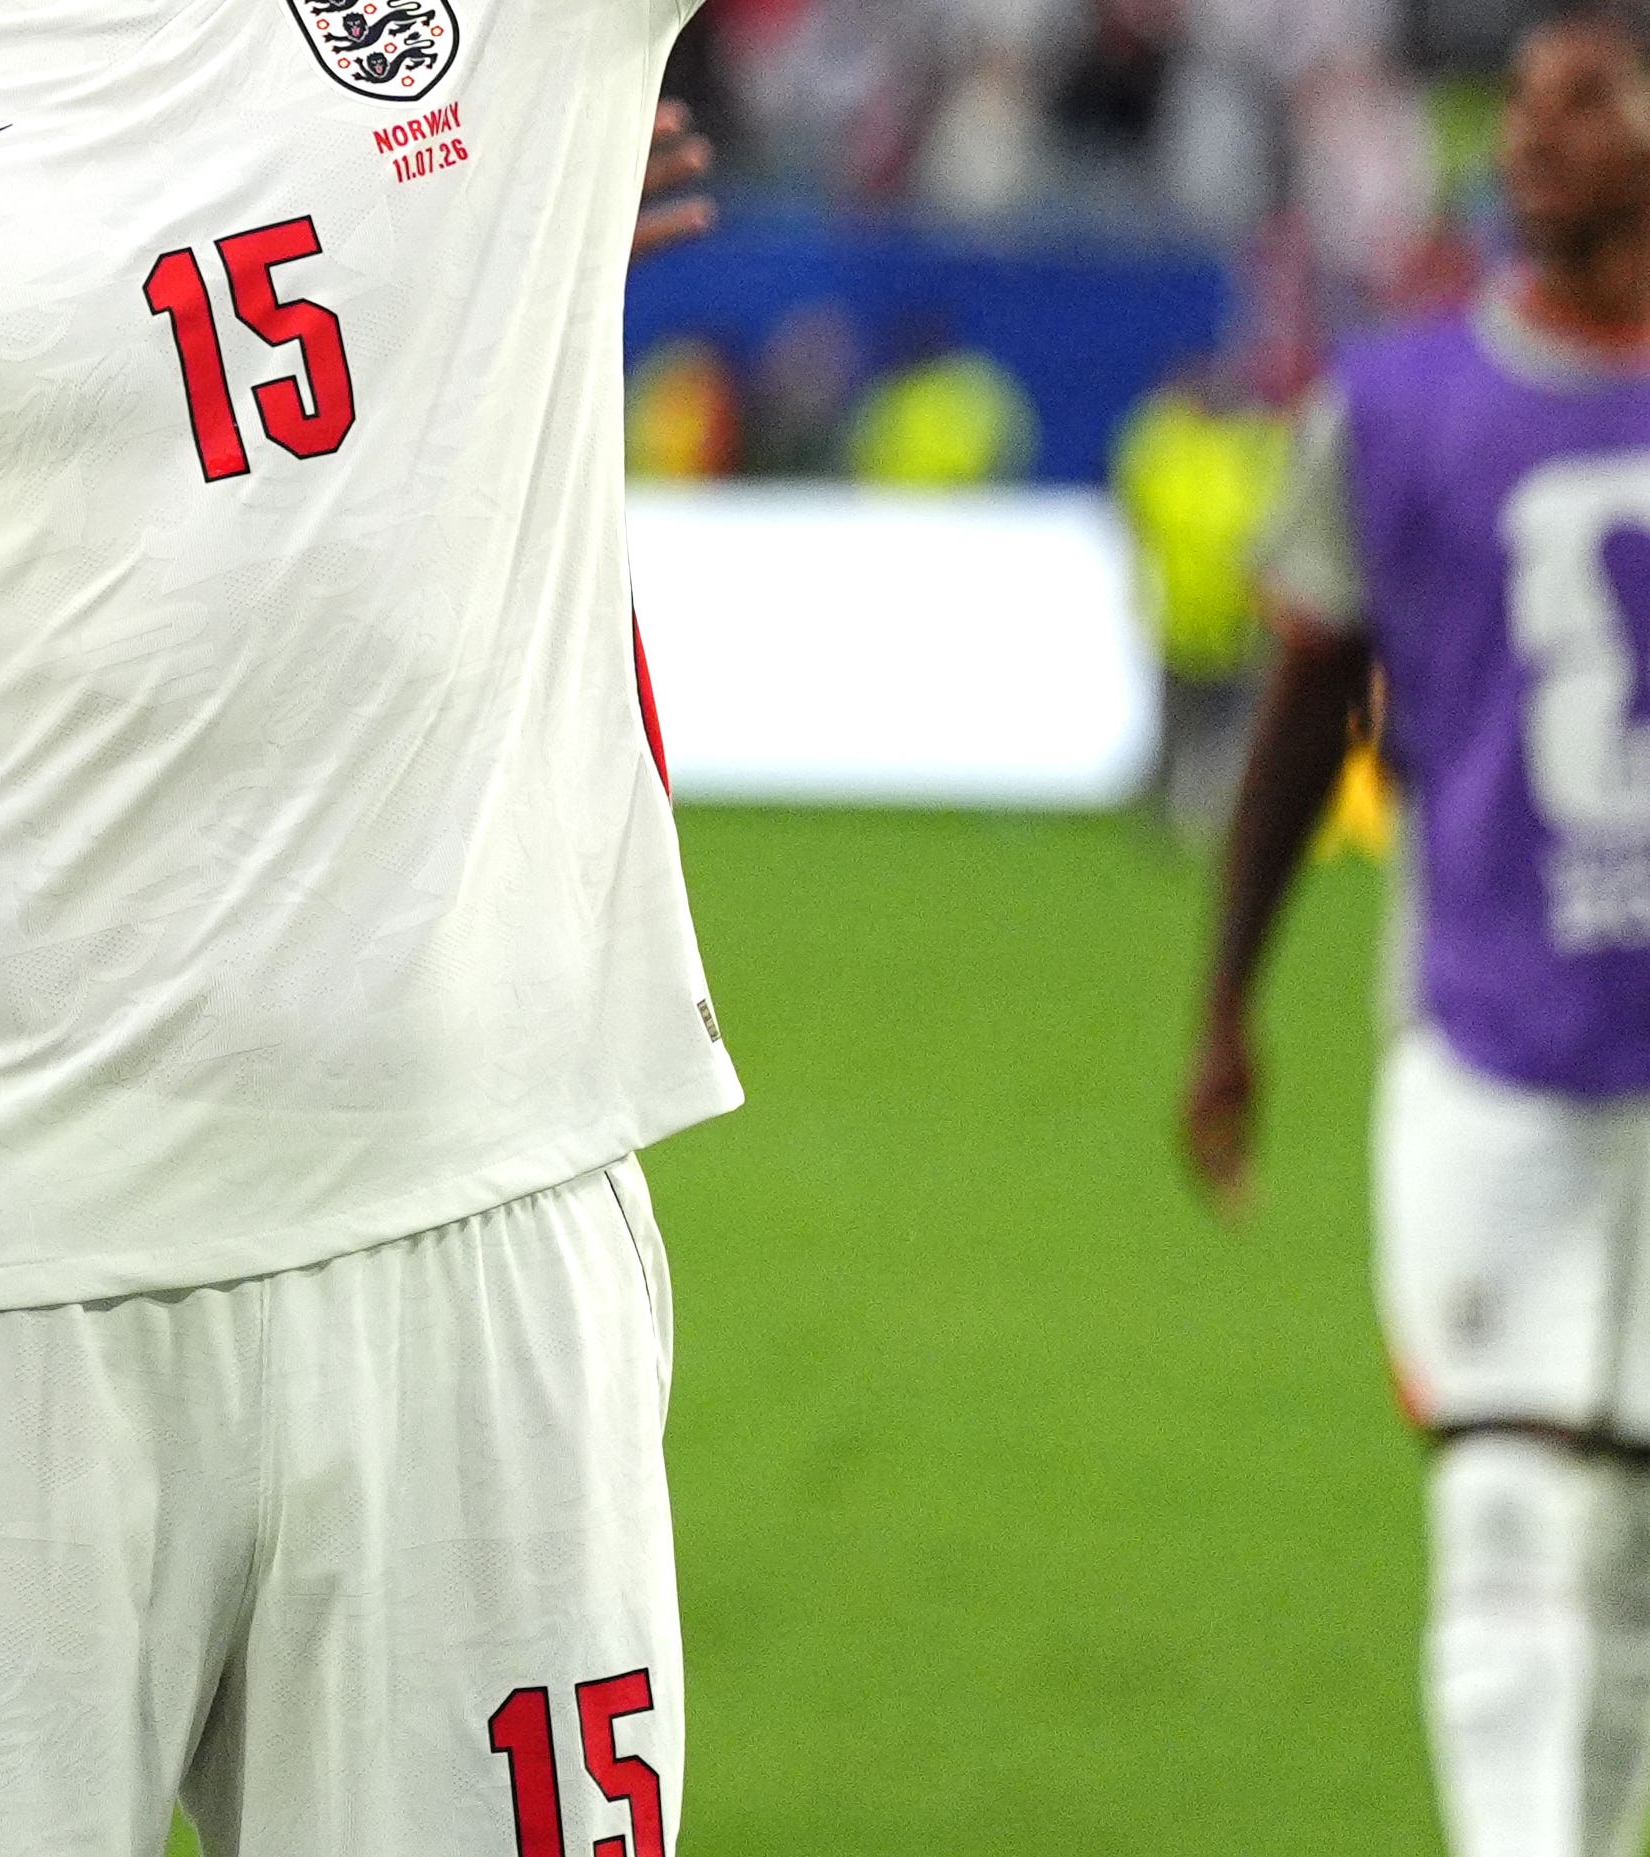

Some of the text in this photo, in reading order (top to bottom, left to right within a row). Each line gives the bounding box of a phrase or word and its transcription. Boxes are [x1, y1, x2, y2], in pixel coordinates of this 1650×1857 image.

[373, 101, 461, 155] NORWAY
[392, 138, 469, 184] 11.07.26
[142, 215, 356, 483] 15
[488, 1667, 665, 1857] 15
